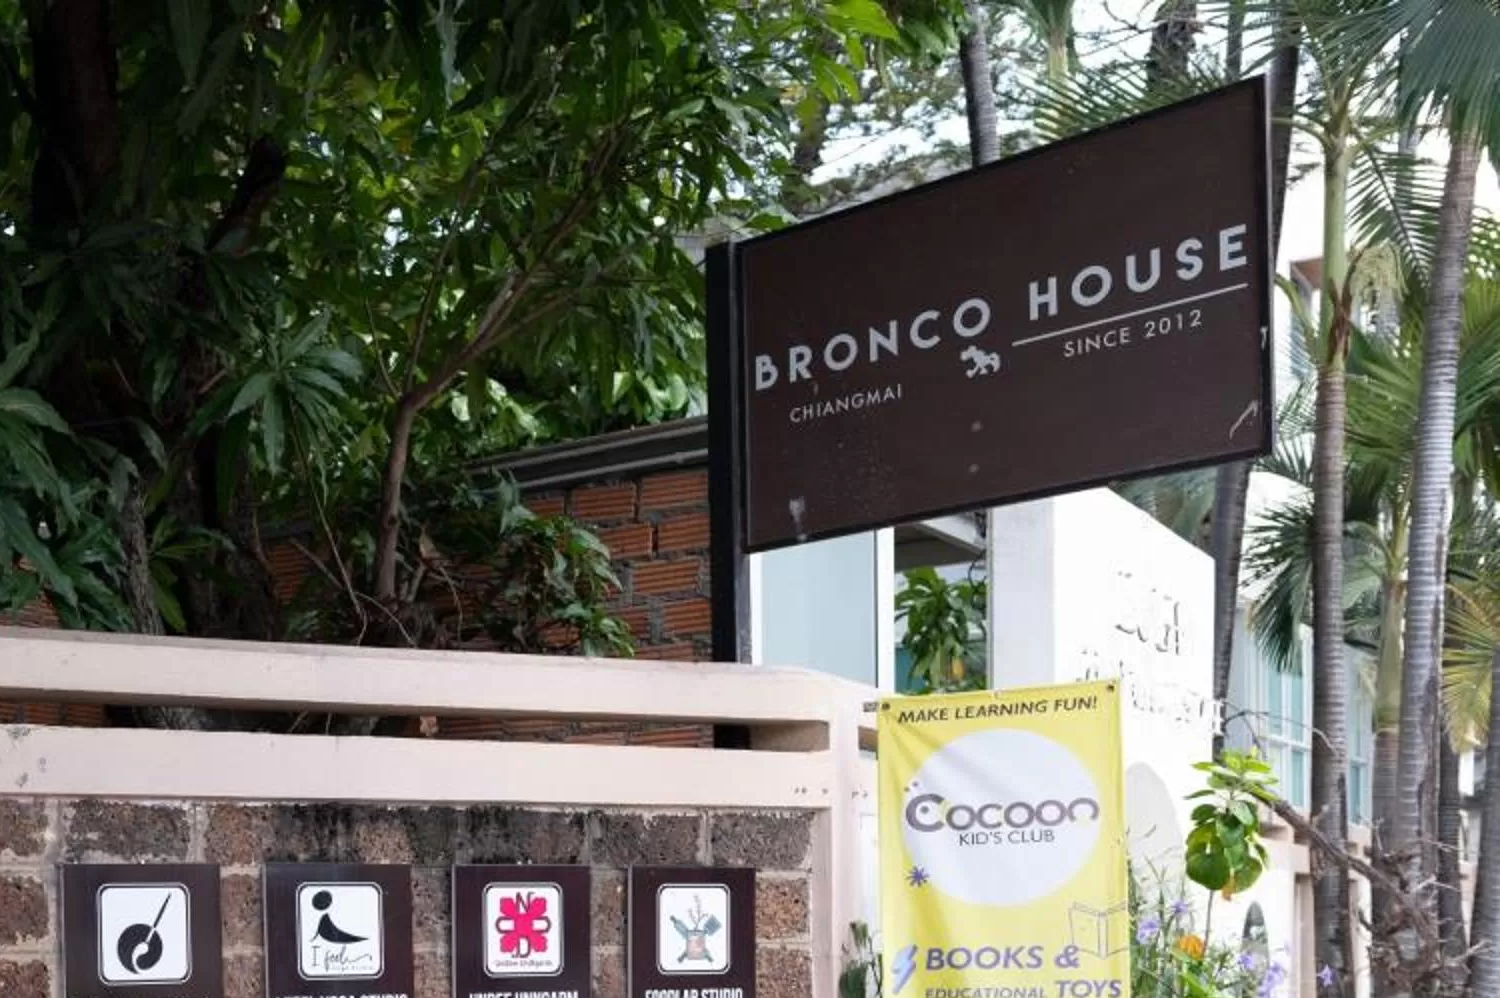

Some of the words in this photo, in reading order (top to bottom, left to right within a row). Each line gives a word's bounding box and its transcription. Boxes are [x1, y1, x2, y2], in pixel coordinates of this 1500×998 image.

[755, 298, 992, 392] BRONCO
[1029, 224, 1248, 321] HOUSE
[1064, 326, 1131, 359] SINCE
[1143, 308, 1203, 339] 2012
[789, 384, 902, 424] CHIANGMAI
[898, 708, 949, 724] MAKE
[955, 700, 1048, 719] LEARNING
[1053, 696, 1098, 712] FUN!
[959, 831, 1002, 847] KID'S
[1008, 830, 1055, 844] CLUB
[925, 946, 1045, 971] BOOKS
[1053, 945, 1080, 968] &
[1055, 979, 1123, 998] TOYS
